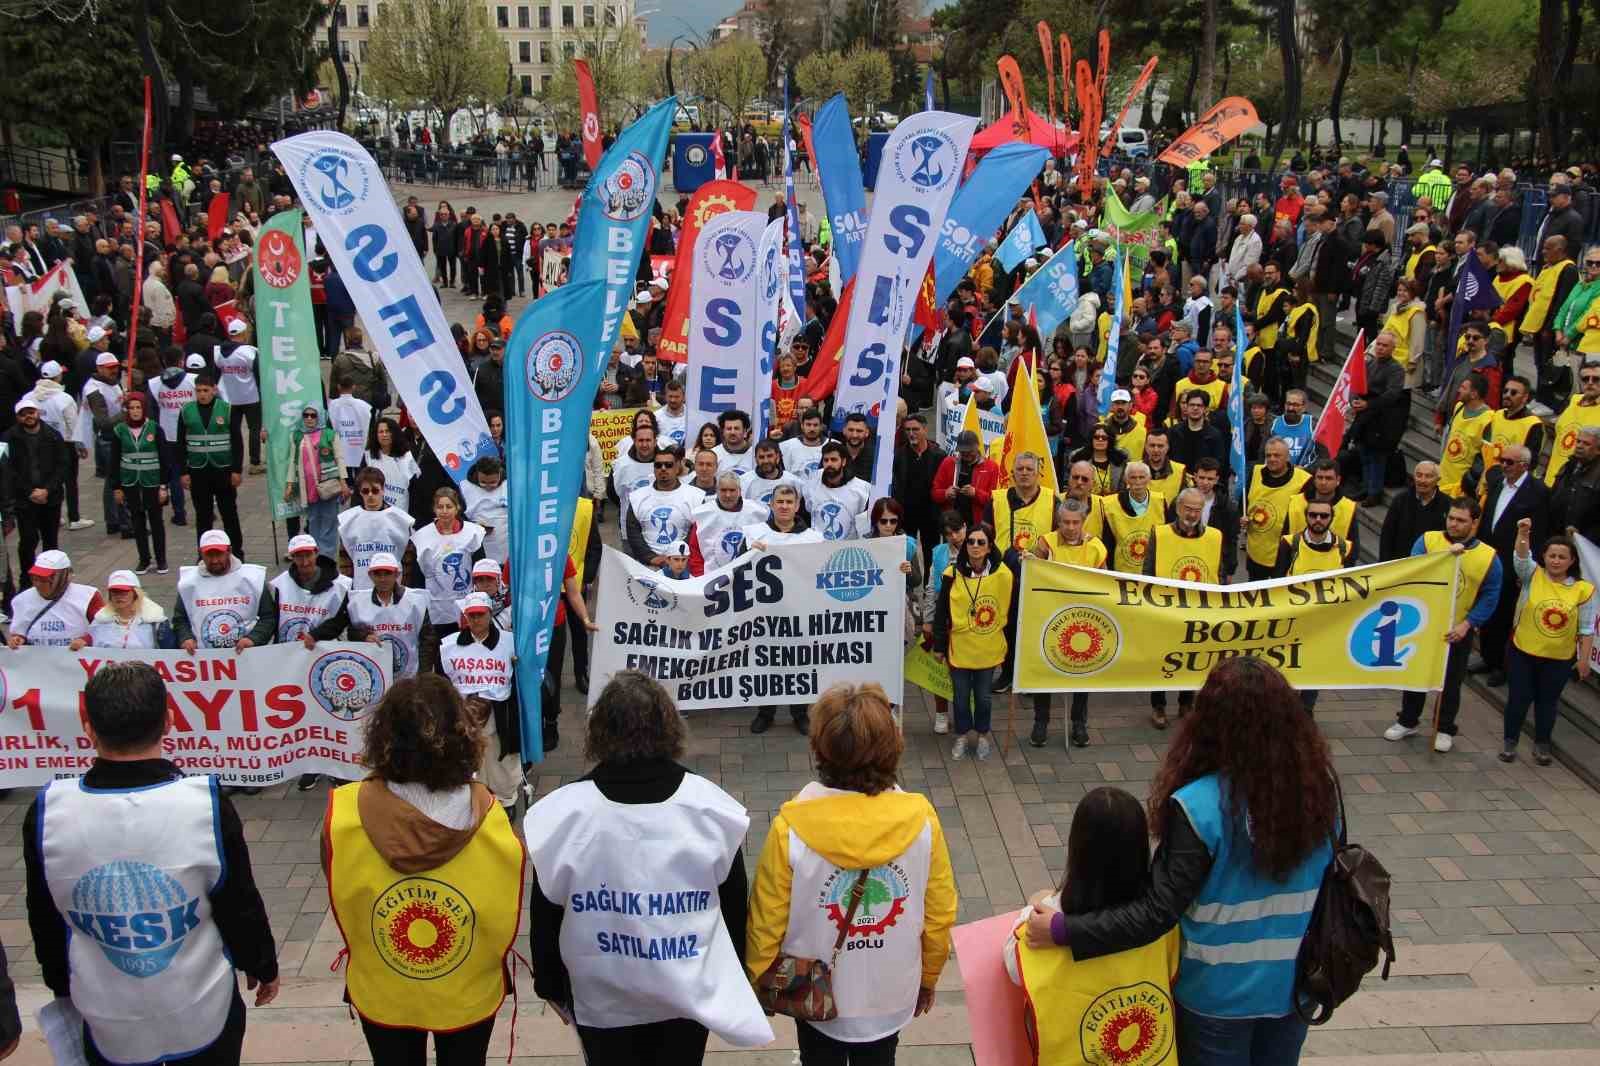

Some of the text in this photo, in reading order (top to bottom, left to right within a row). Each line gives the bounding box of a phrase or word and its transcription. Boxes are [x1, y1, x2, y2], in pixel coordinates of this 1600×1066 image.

[660, 338, 688, 354] PAR
[703, 551, 885, 618] SES KESK
[1287, 575, 1371, 607] SEN
[614, 609, 888, 651] SAĞLIK VE SOSYAL HİZMET
[1182, 617, 1297, 645] BOLU
[626, 641, 872, 681] EMEKÇİLERİ SENDİKASI
[677, 668, 818, 703] BOLU ŞUBESİ
[12, 688, 46, 731] 1
[227, 726, 348, 752] MÜCADELE
[240, 768, 284, 784] ŞUBESİ
[376, 885, 438, 920] EĞİTİM
[571, 881, 712, 916] SAĞLIK HAKTIR
[67, 896, 201, 950] KESK
[596, 931, 700, 961] SATILAMAZ
[846, 938, 884, 951] BOLU
